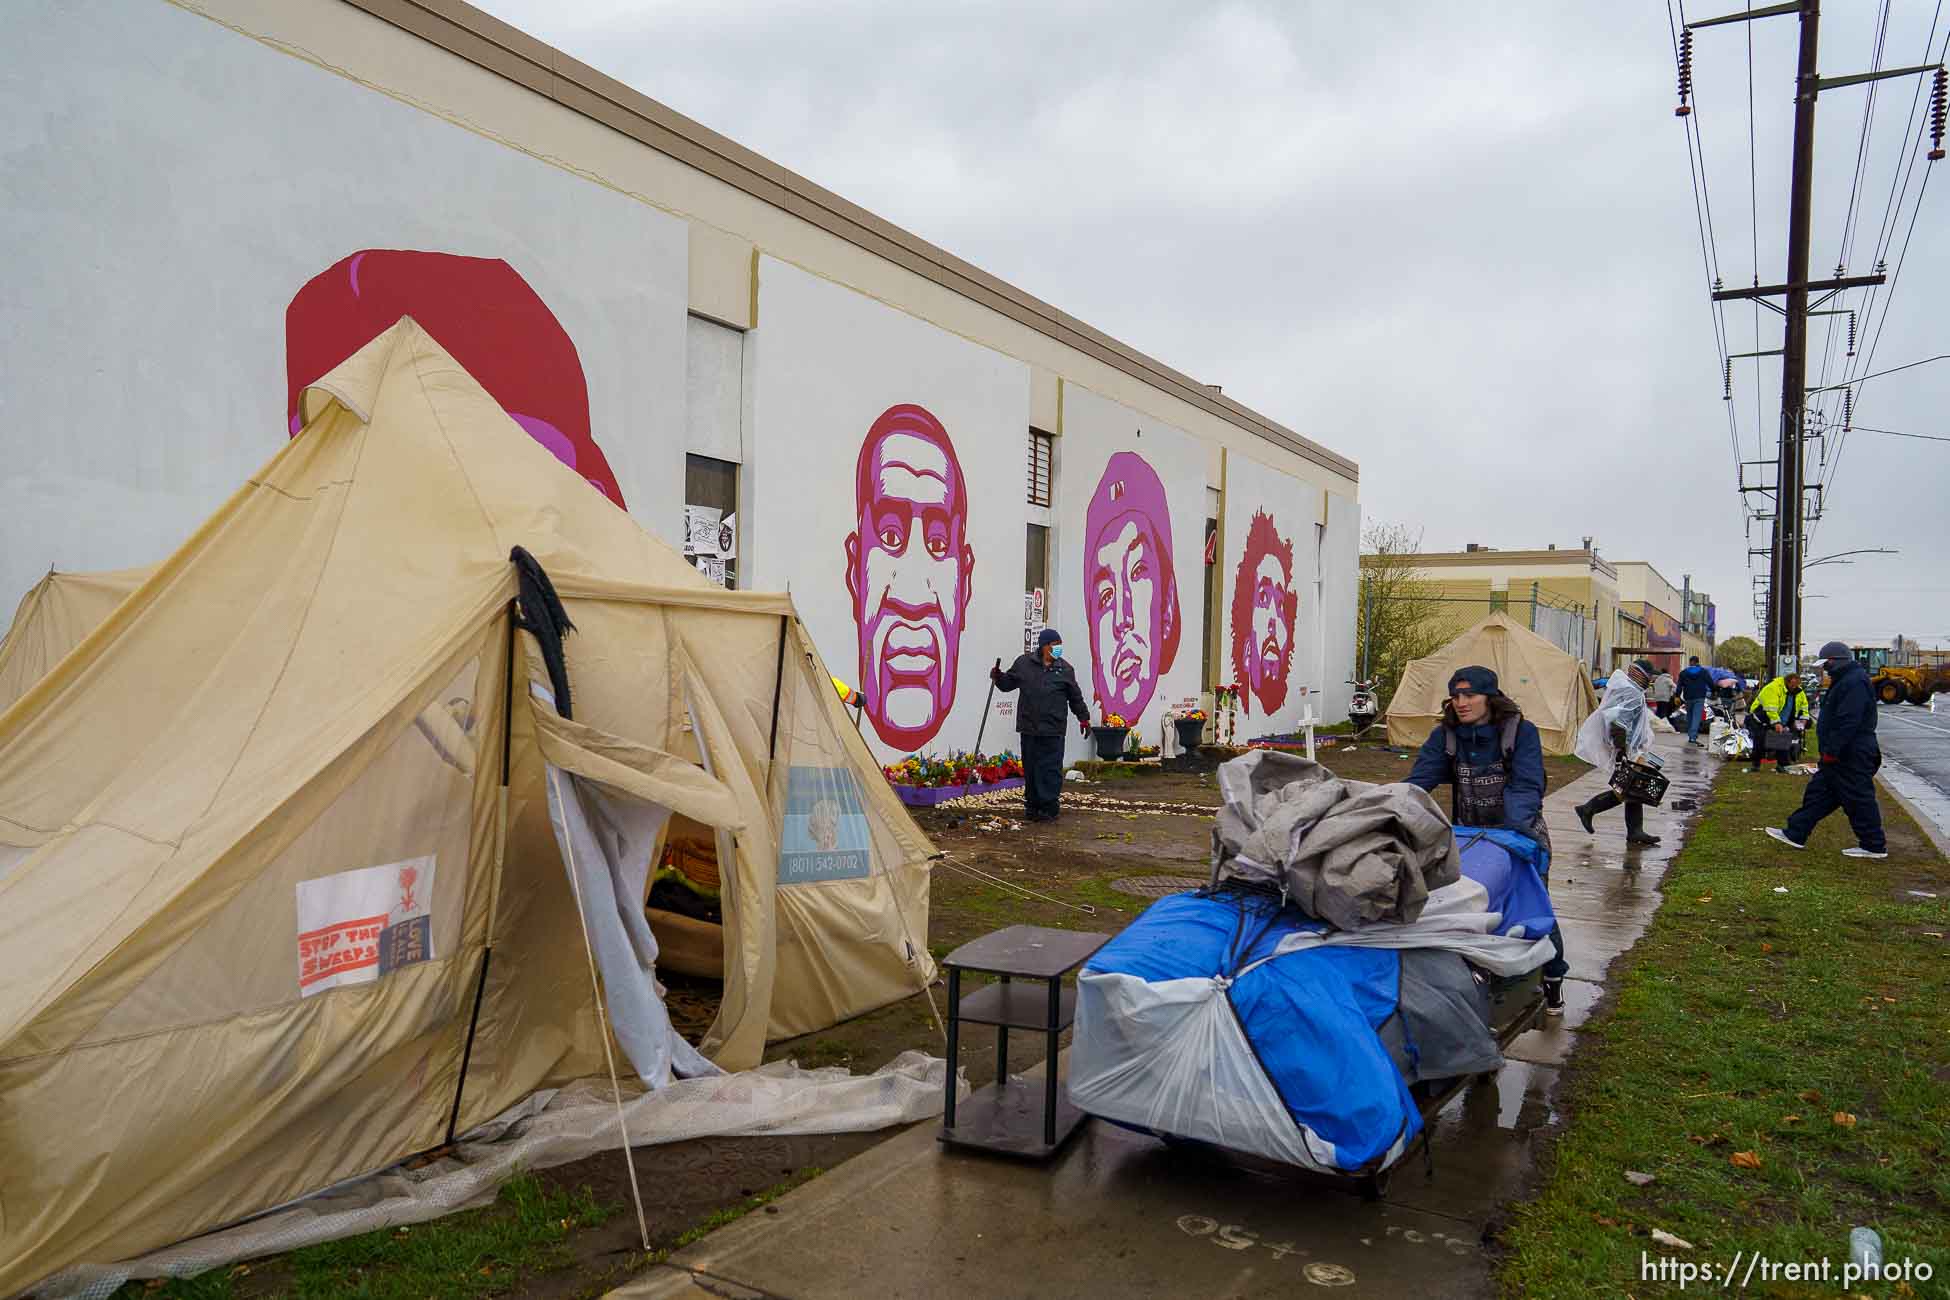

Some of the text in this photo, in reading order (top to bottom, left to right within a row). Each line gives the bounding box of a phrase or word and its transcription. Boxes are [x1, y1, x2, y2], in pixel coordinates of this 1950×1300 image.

[300, 927, 380, 958] STOP THE
[302, 944, 378, 977] SWEEPS
